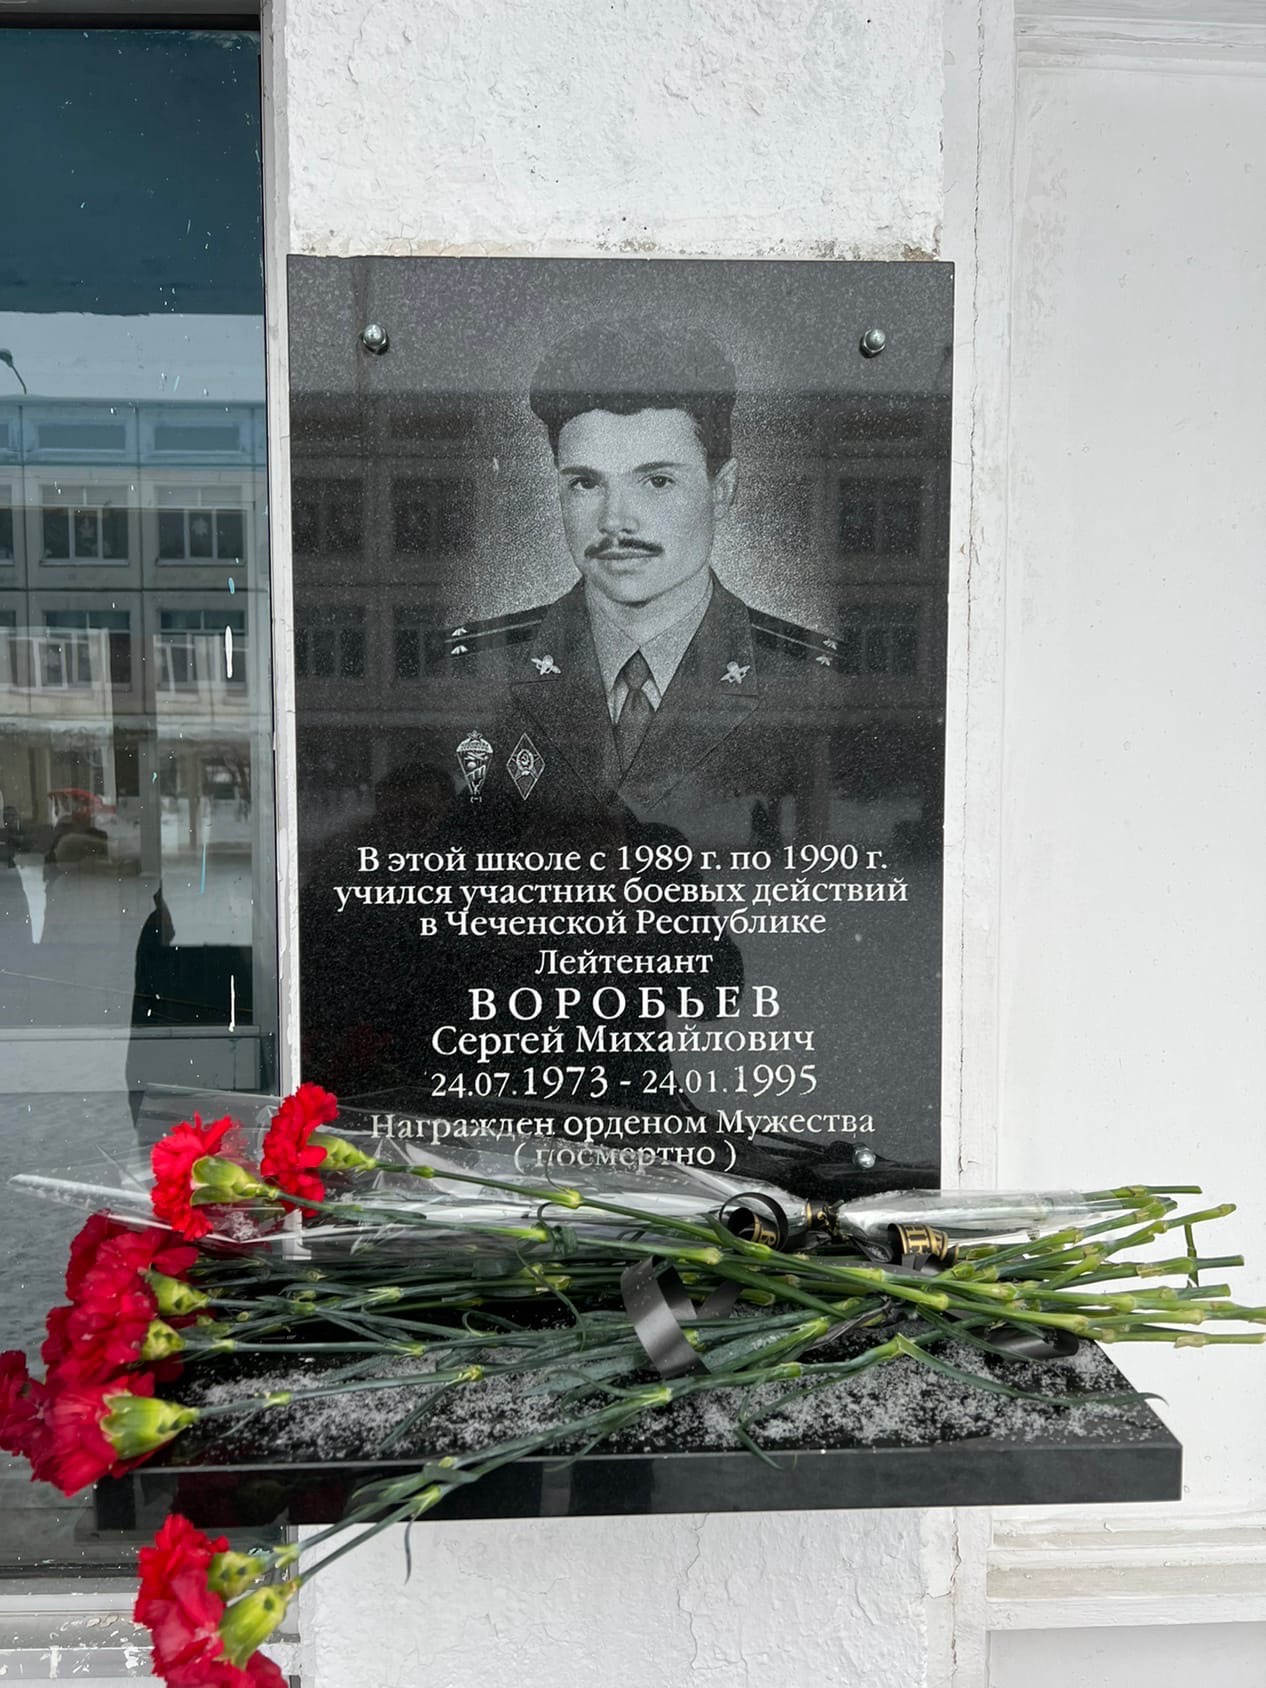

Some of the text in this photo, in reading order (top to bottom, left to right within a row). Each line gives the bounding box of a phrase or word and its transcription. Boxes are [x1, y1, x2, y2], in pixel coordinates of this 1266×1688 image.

[357, 844, 888, 874] В этой школе с 1989 г. по 1990 г.
[333, 876, 909, 912] учился участник боевых действий
[419, 908, 827, 942] в Чеченской Республике
[534, 949, 714, 975] Лейтенант
[468, 985, 780, 1021] ВОРОБЬЕВ
[431, 1024, 815, 1063] Сергей Михайлович
[431, 1065, 608, 1099] 24.07.1973
[642, 1063, 817, 1098] 24.01.1995
[370, 1108, 876, 1145] Награжден орденом Мужества
